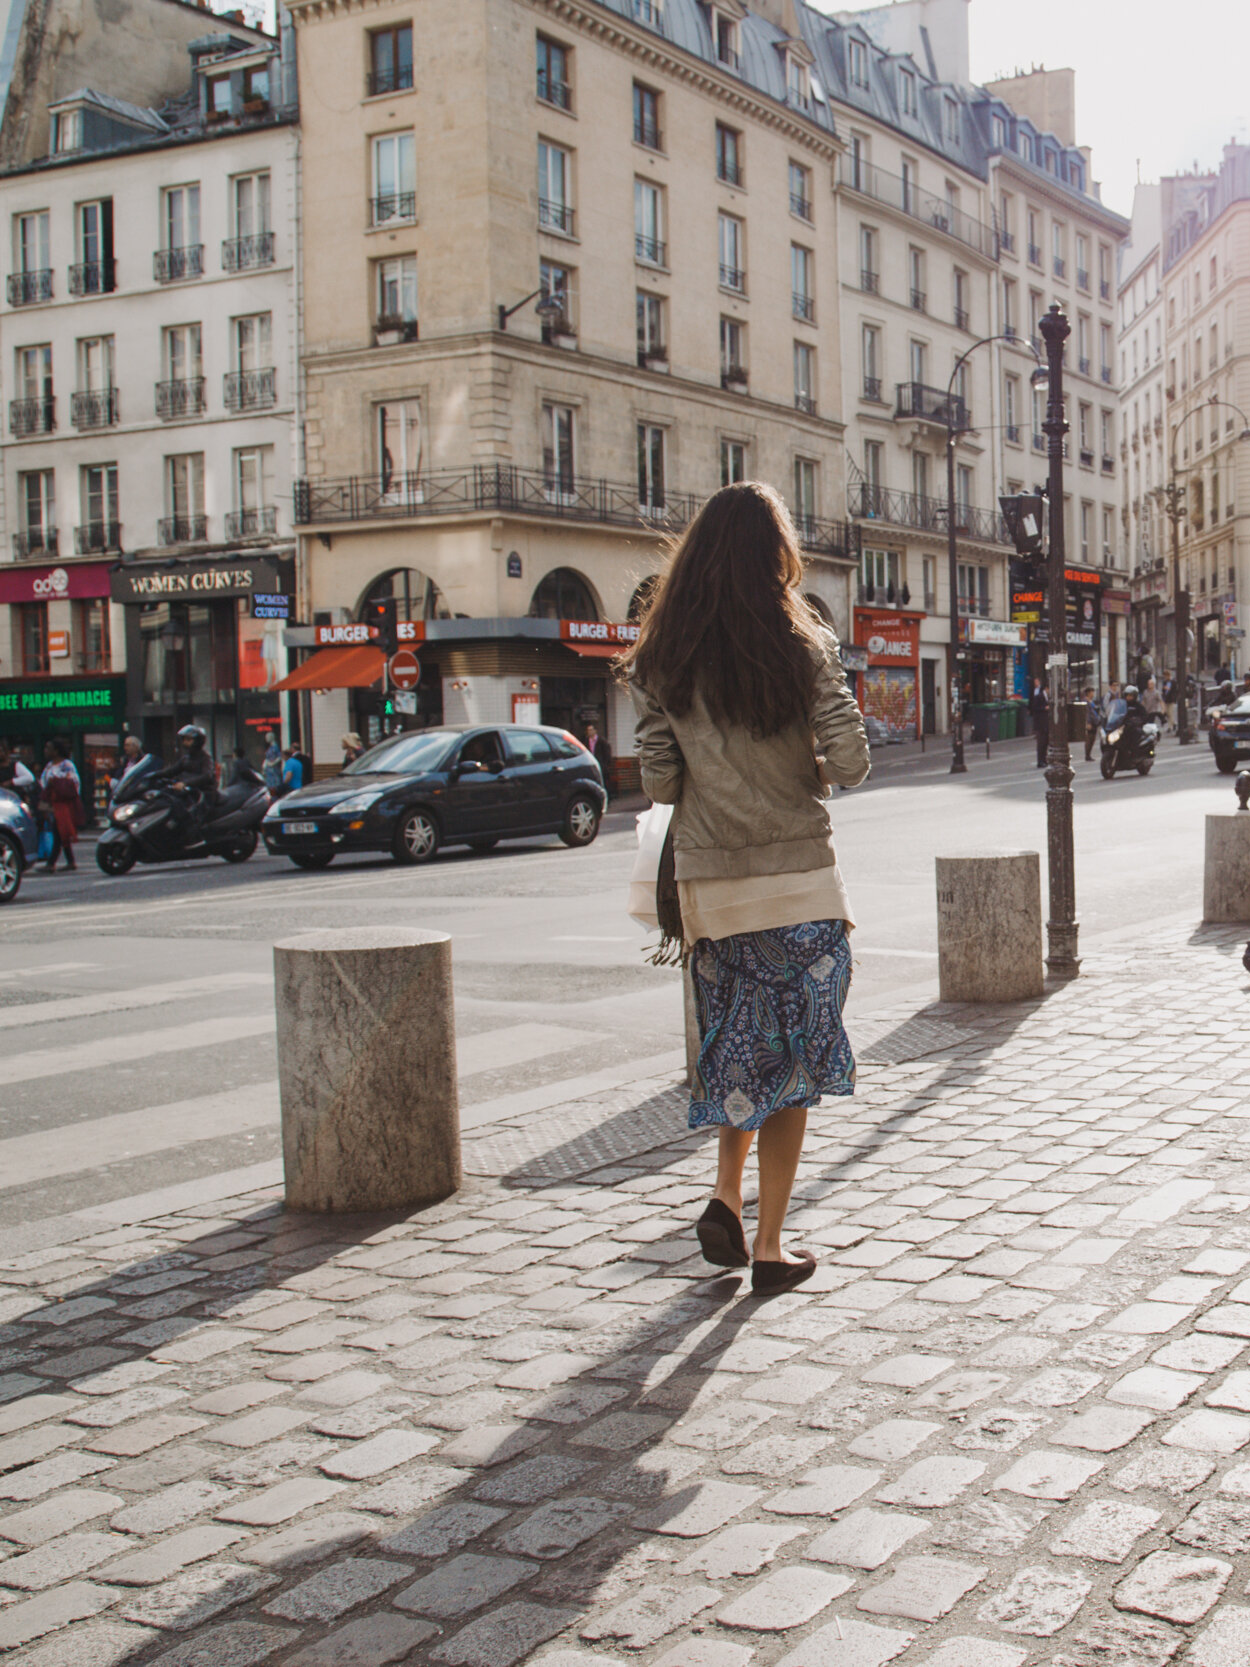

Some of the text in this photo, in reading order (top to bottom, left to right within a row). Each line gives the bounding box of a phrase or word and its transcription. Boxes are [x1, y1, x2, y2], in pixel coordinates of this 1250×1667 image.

[130, 570, 252, 593] WOMEN CURVES
[254, 594, 288, 605] WOMEN
[1013, 592, 1043, 603] CHANGE
[320, 626, 369, 642] BURGER
[396, 623, 416, 639] IES
[569, 622, 608, 639] BURGER
[1066, 632, 1093, 645] CHANGE
[22, 690, 112, 709] PARAPHARMACIE
